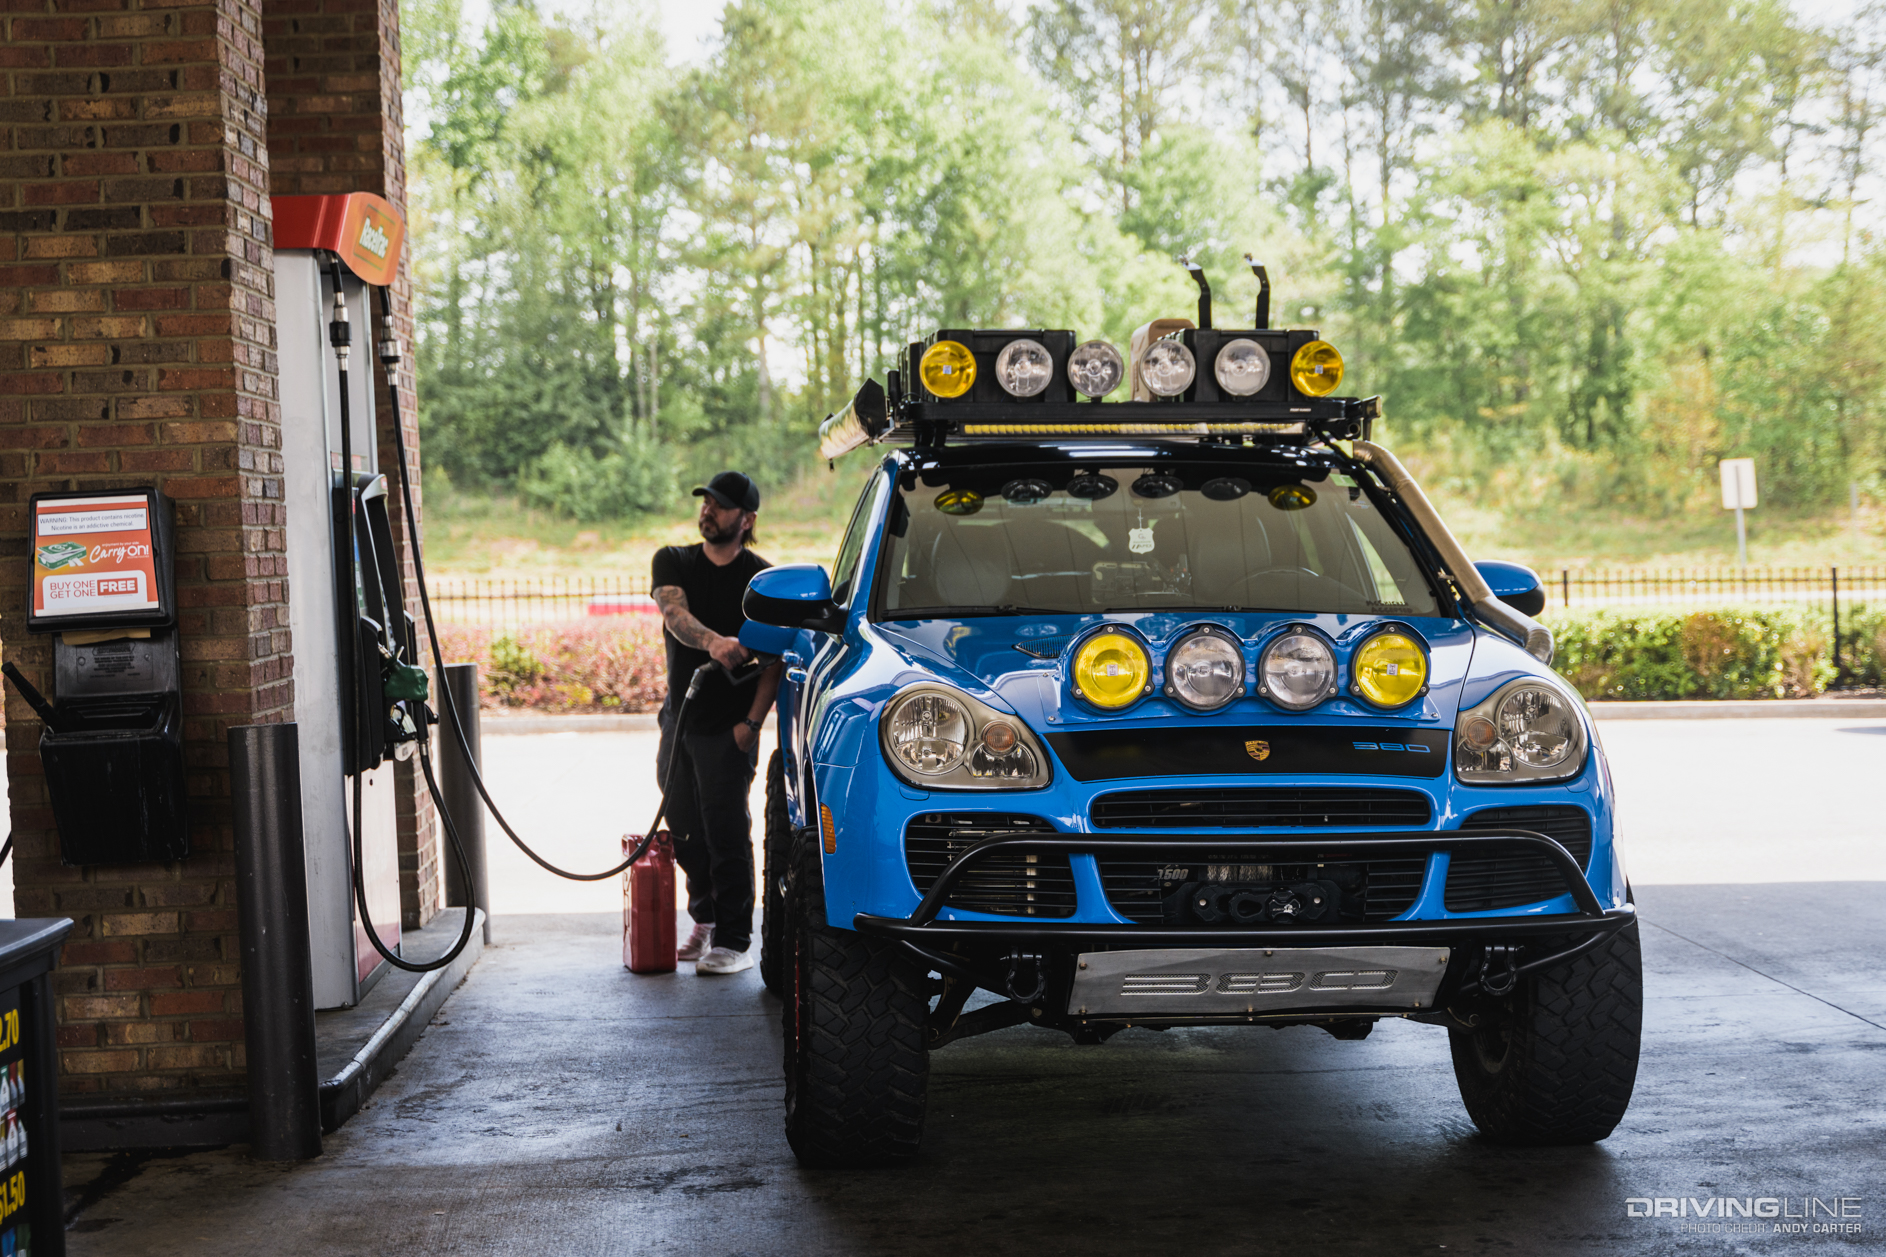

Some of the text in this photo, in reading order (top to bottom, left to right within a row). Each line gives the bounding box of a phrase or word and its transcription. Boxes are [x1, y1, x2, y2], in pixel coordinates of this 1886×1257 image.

[81, 515, 100, 523] product
[90, 545, 126, 564] Carry
[50, 580, 95, 591] BUY ONE
[100, 580, 136, 593] FREE
[50, 589, 96, 599] GET ONE
[1352, 741, 1431, 753] 380
[1121, 969, 1398, 996] 380
